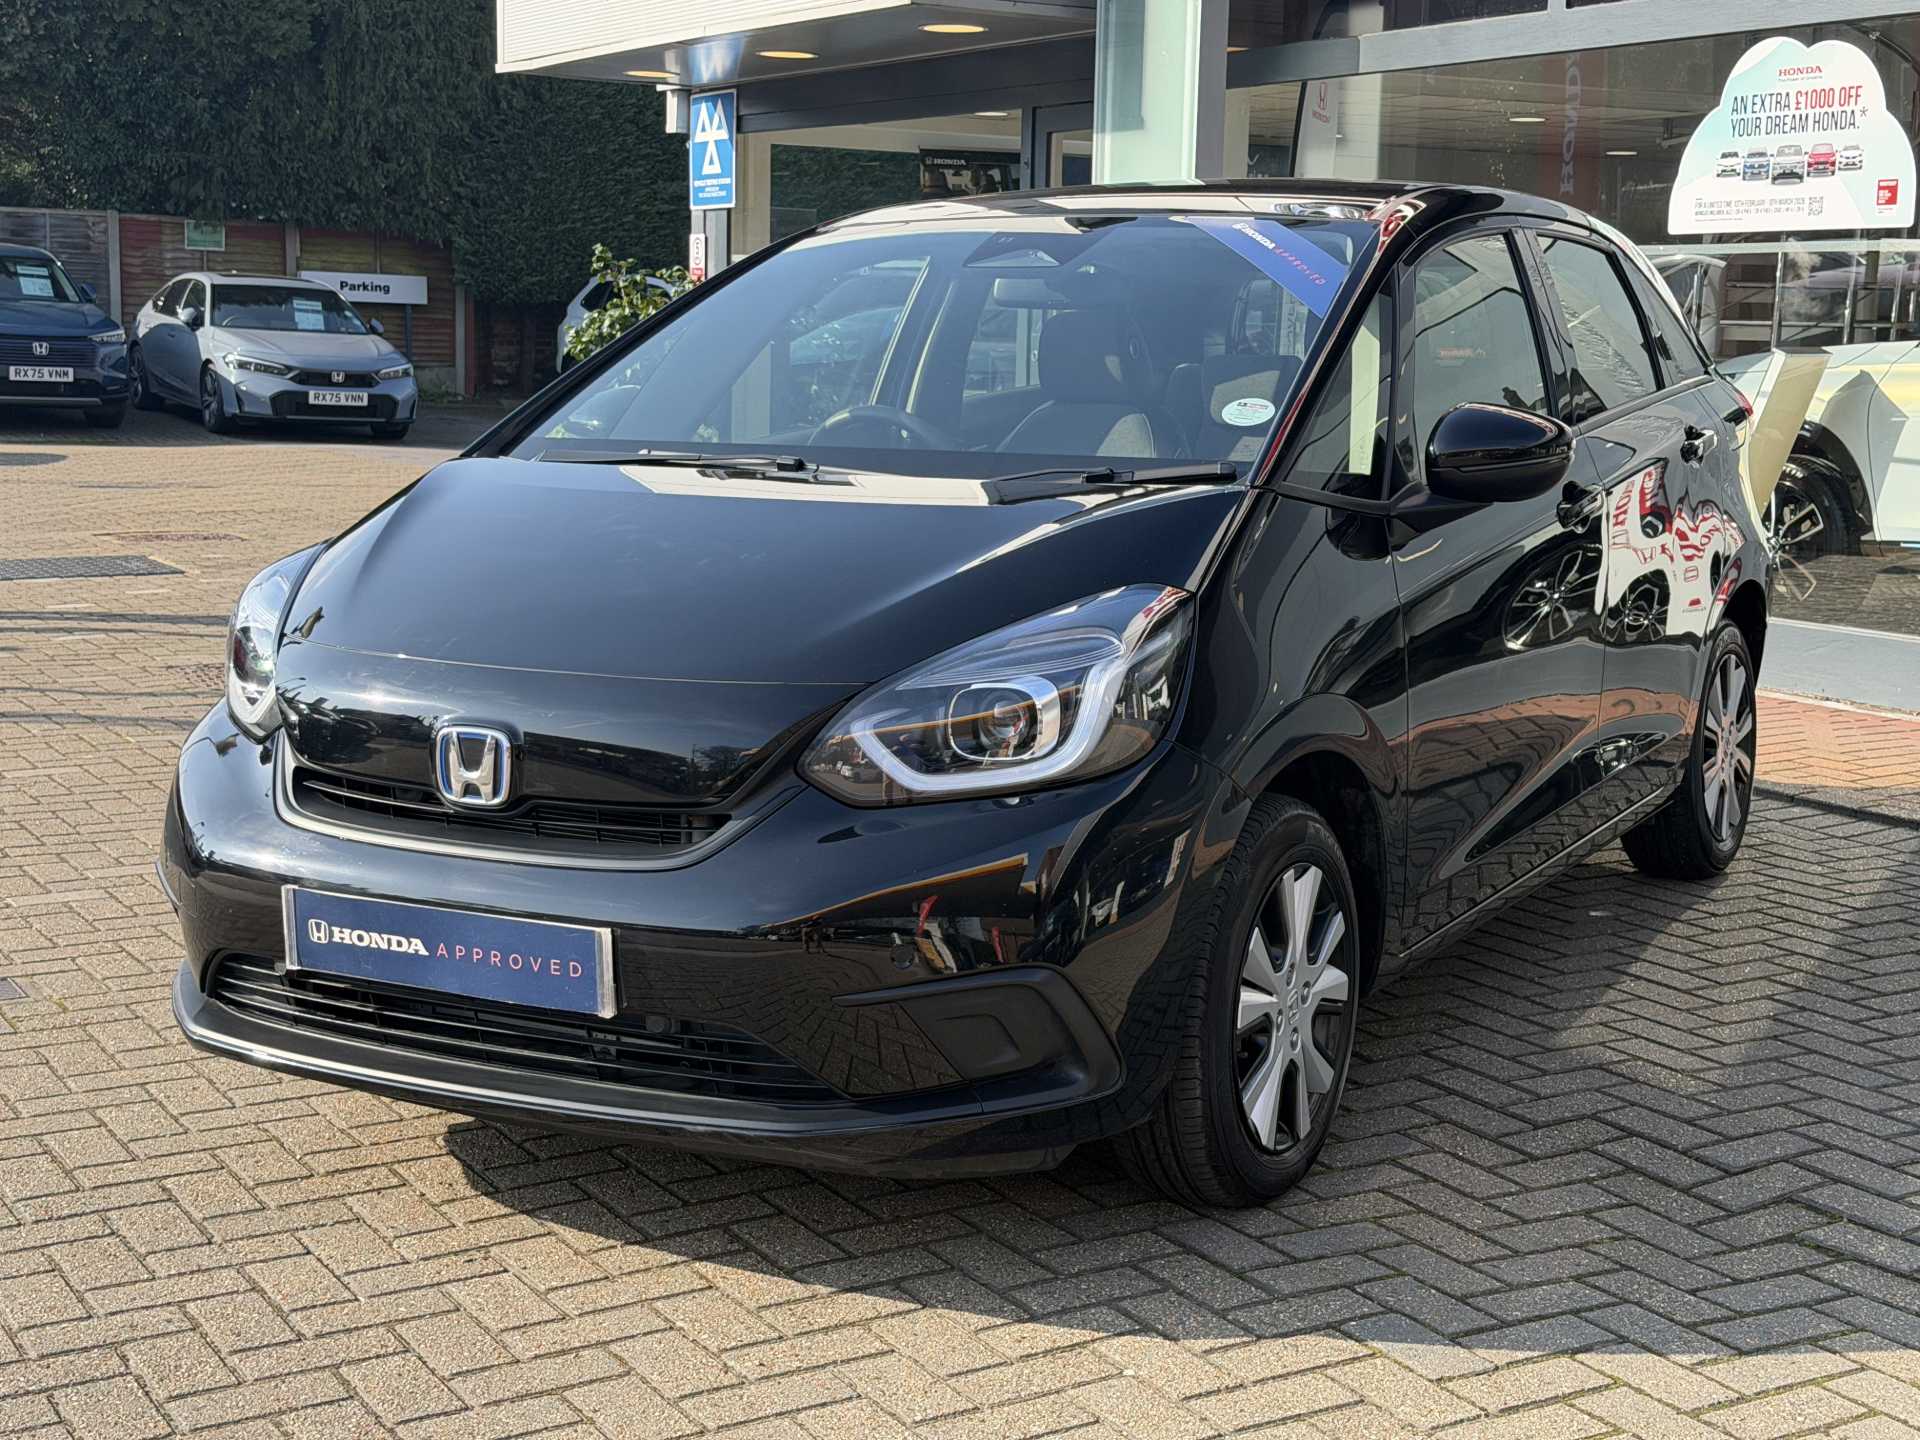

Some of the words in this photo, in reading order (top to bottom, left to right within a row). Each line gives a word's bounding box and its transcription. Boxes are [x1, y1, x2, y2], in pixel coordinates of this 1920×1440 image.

[1778, 65, 1823, 77] HONDA
[1731, 95, 1749, 116] AN
[1751, 91, 1790, 114] EXTRA
[1795, 87, 1836, 111] £1000
[1838, 85, 1863, 107] OFF
[1730, 115, 1762, 138] YOUR
[1765, 111, 1809, 134] DREAM
[340, 280, 391, 294] Parking
[14, 367, 45, 379] RX75
[48, 368, 70, 380] VNM
[313, 392, 341, 403] RX75
[331, 926, 430, 956] HONDA
[436, 943, 582, 977] APPROVED
